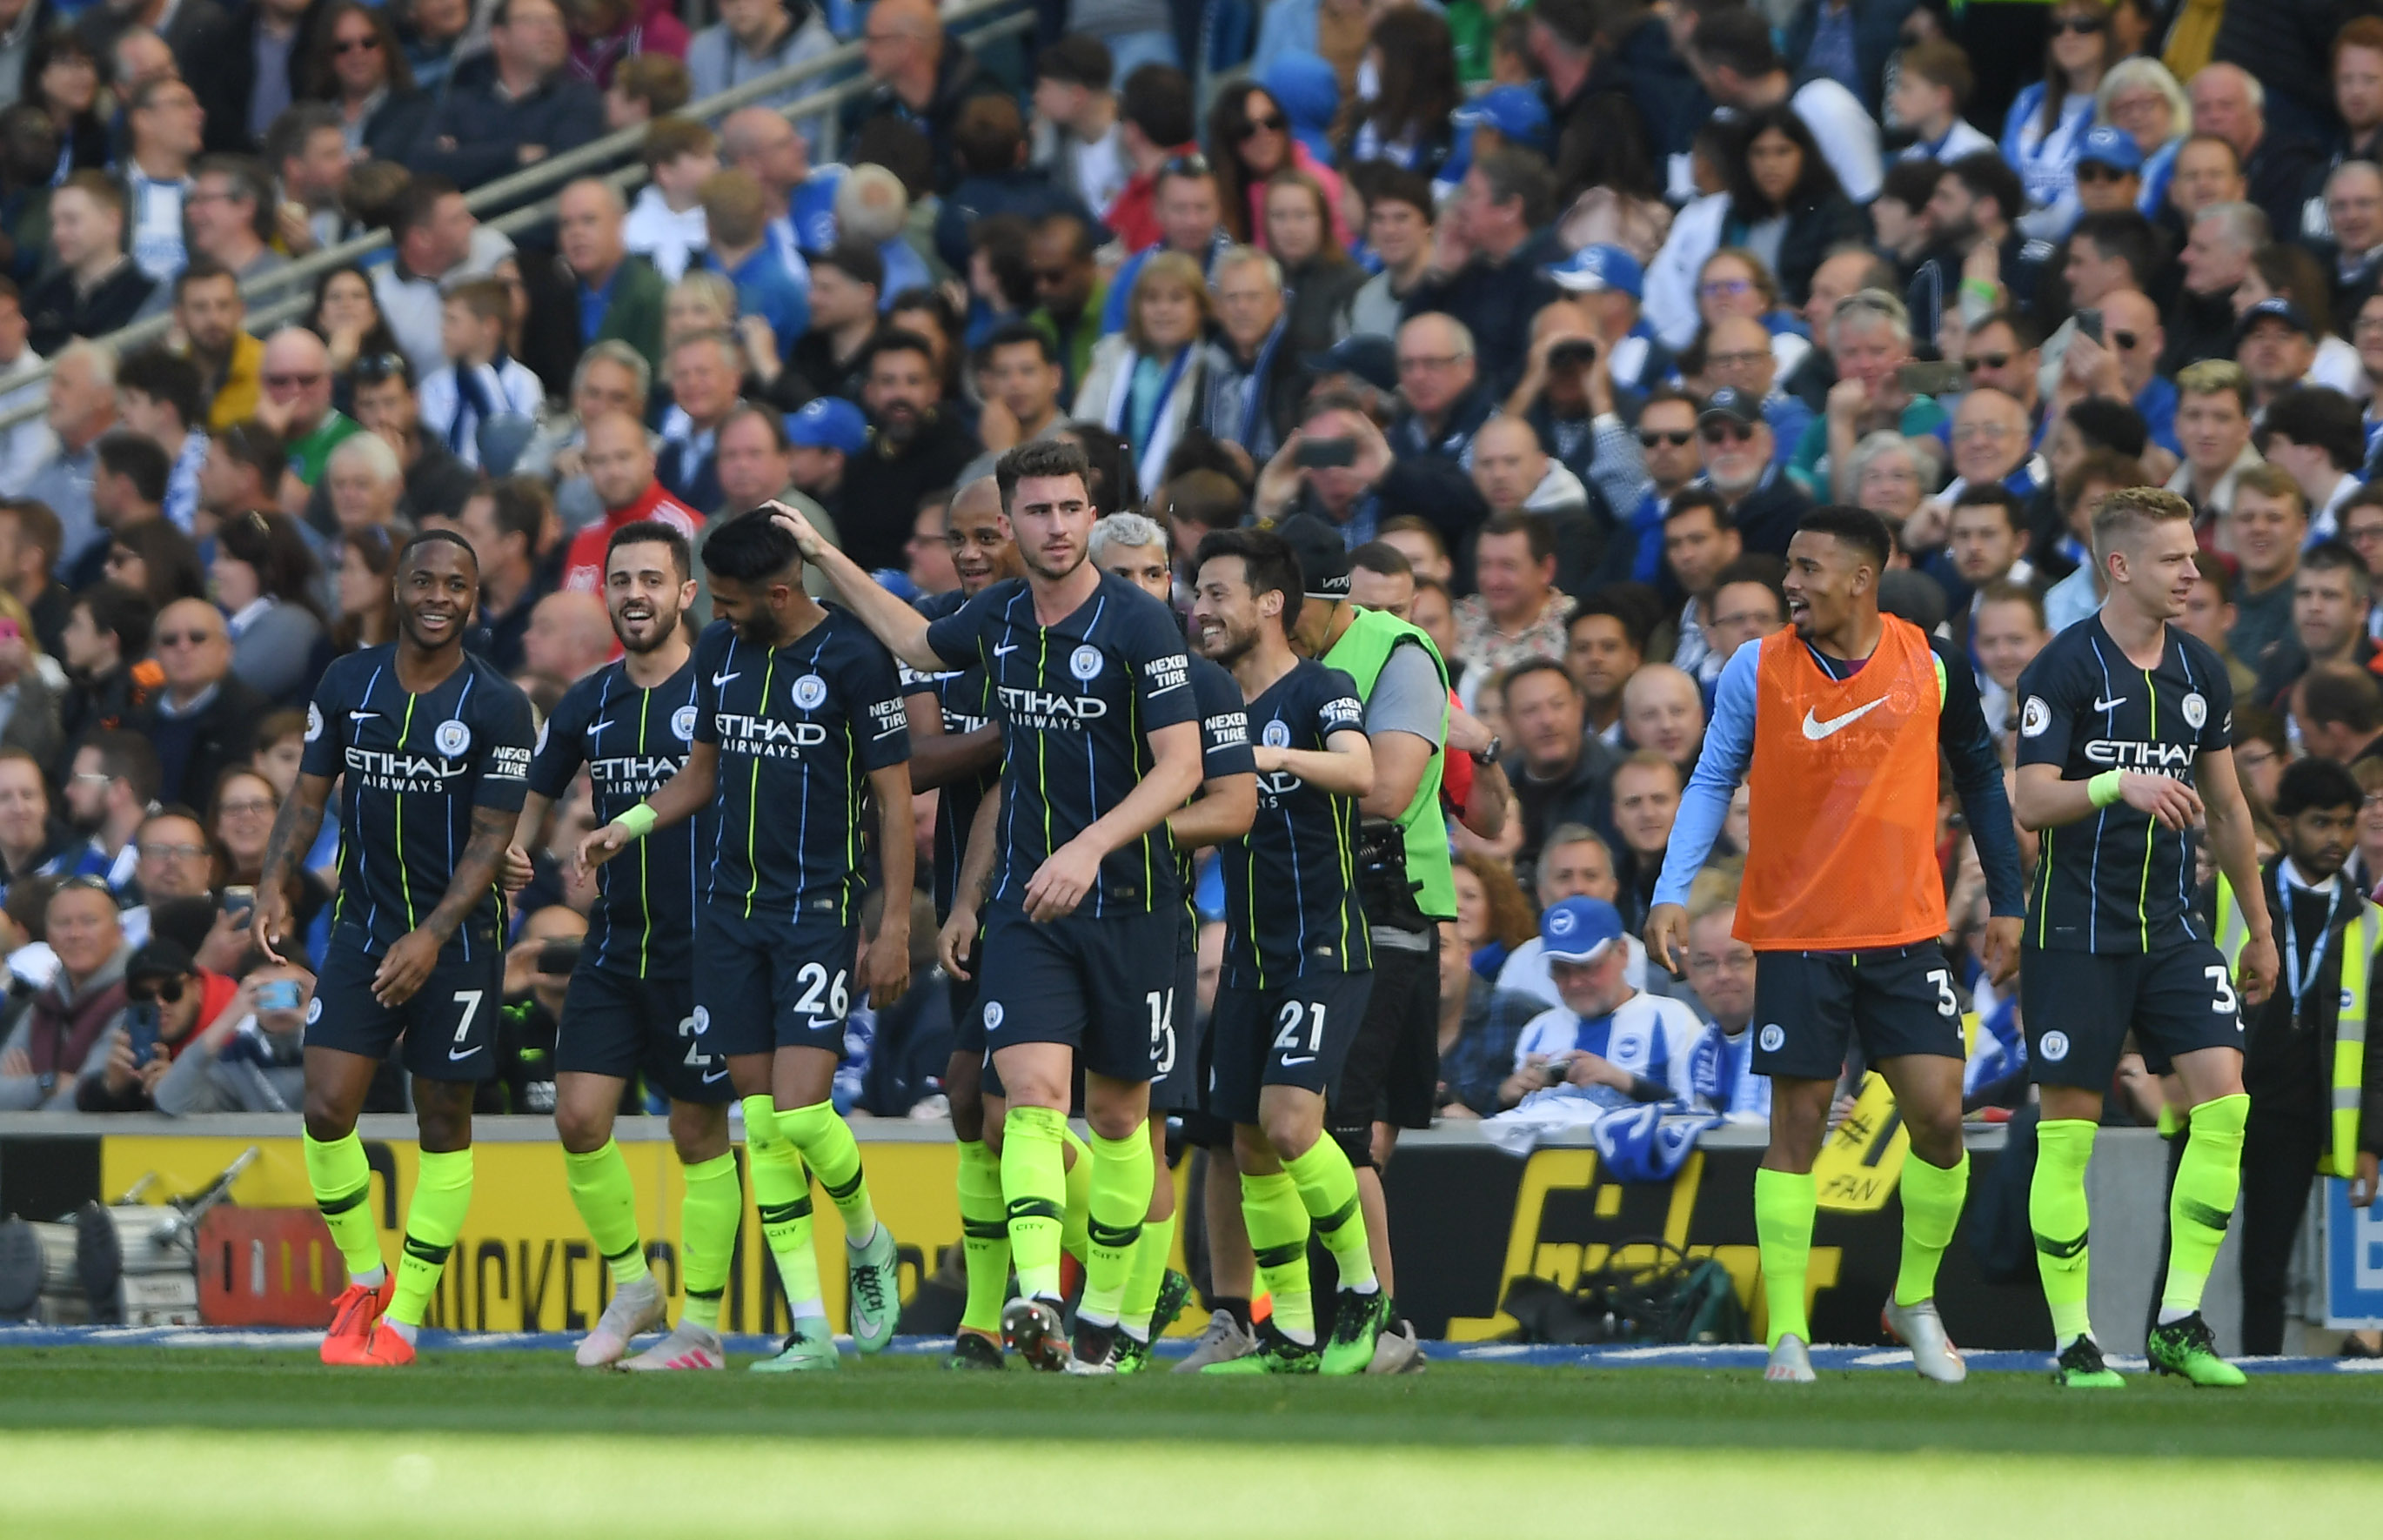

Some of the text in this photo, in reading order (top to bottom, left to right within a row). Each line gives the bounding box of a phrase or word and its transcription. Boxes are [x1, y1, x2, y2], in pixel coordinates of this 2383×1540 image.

[1144, 654, 1188, 675] NEXEN
[1155, 669, 1186, 687] TIRE
[869, 696, 905, 717] NEXE
[997, 686, 1107, 719] ETIHAD
[1318, 697, 1362, 718] NEXEN
[715, 713, 827, 746] ETIHAD
[1009, 712, 1081, 731] AIRWAYS
[1205, 712, 1248, 731] NEXEN
[1214, 726, 1247, 744] TIRE
[722, 740, 800, 760] AIRWAYS
[497, 760, 527, 777] TIRE
[362, 773, 443, 793] AIRWAYS
[606, 780, 667, 793] AIRWA
[793, 962, 848, 1021] 26
[1926, 968, 1958, 1016] 3
[2205, 966, 2238, 1014] 3
[452, 989, 483, 1042] 7
[1274, 1000, 1326, 1052] 21
[1821, 1175, 1881, 1202] FAN
[769, 1224, 798, 1237] CITY
[1093, 1249, 1121, 1260] CITY
